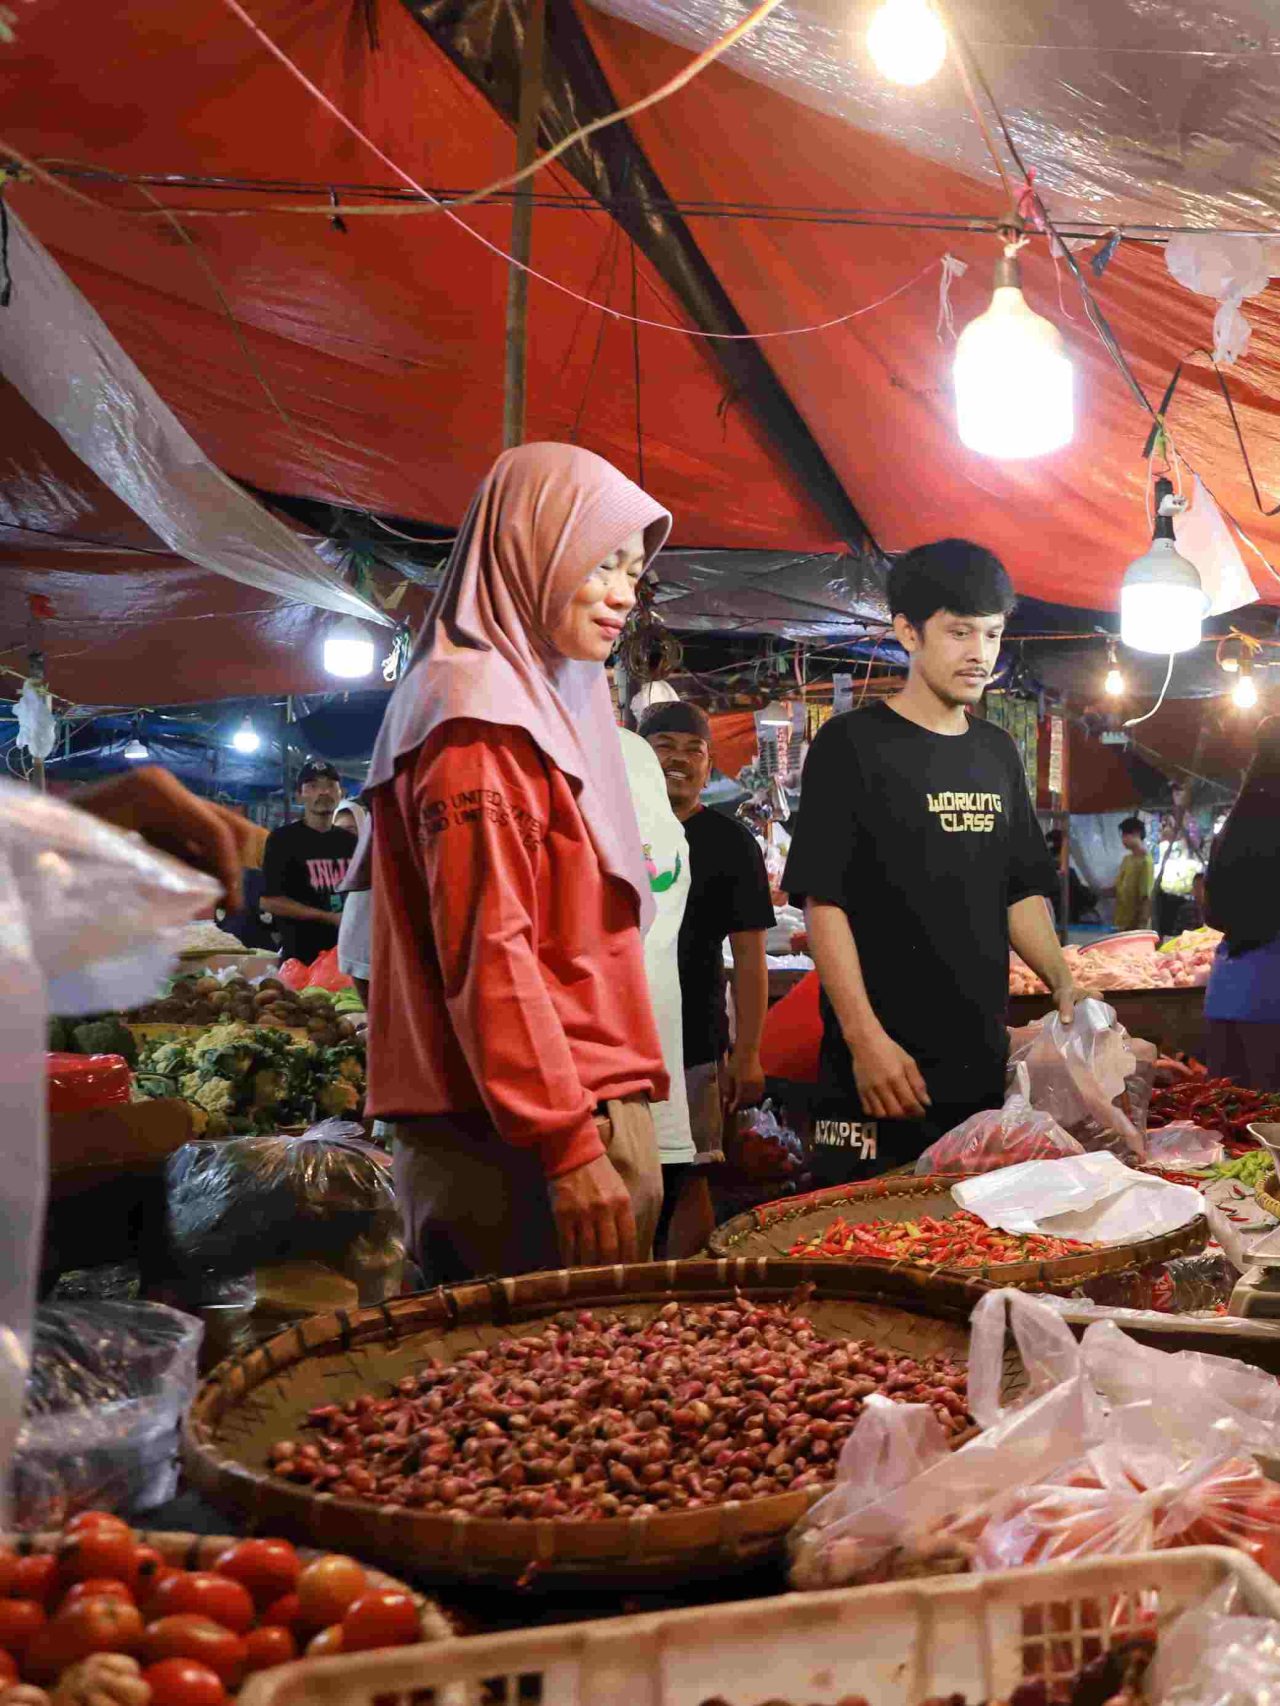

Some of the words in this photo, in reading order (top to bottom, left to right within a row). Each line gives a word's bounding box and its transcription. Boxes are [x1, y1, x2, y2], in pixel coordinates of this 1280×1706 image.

[451, 788, 502, 808] UNITED
[926, 791, 1002, 813] WORKING
[940, 812, 995, 833] CLASS
